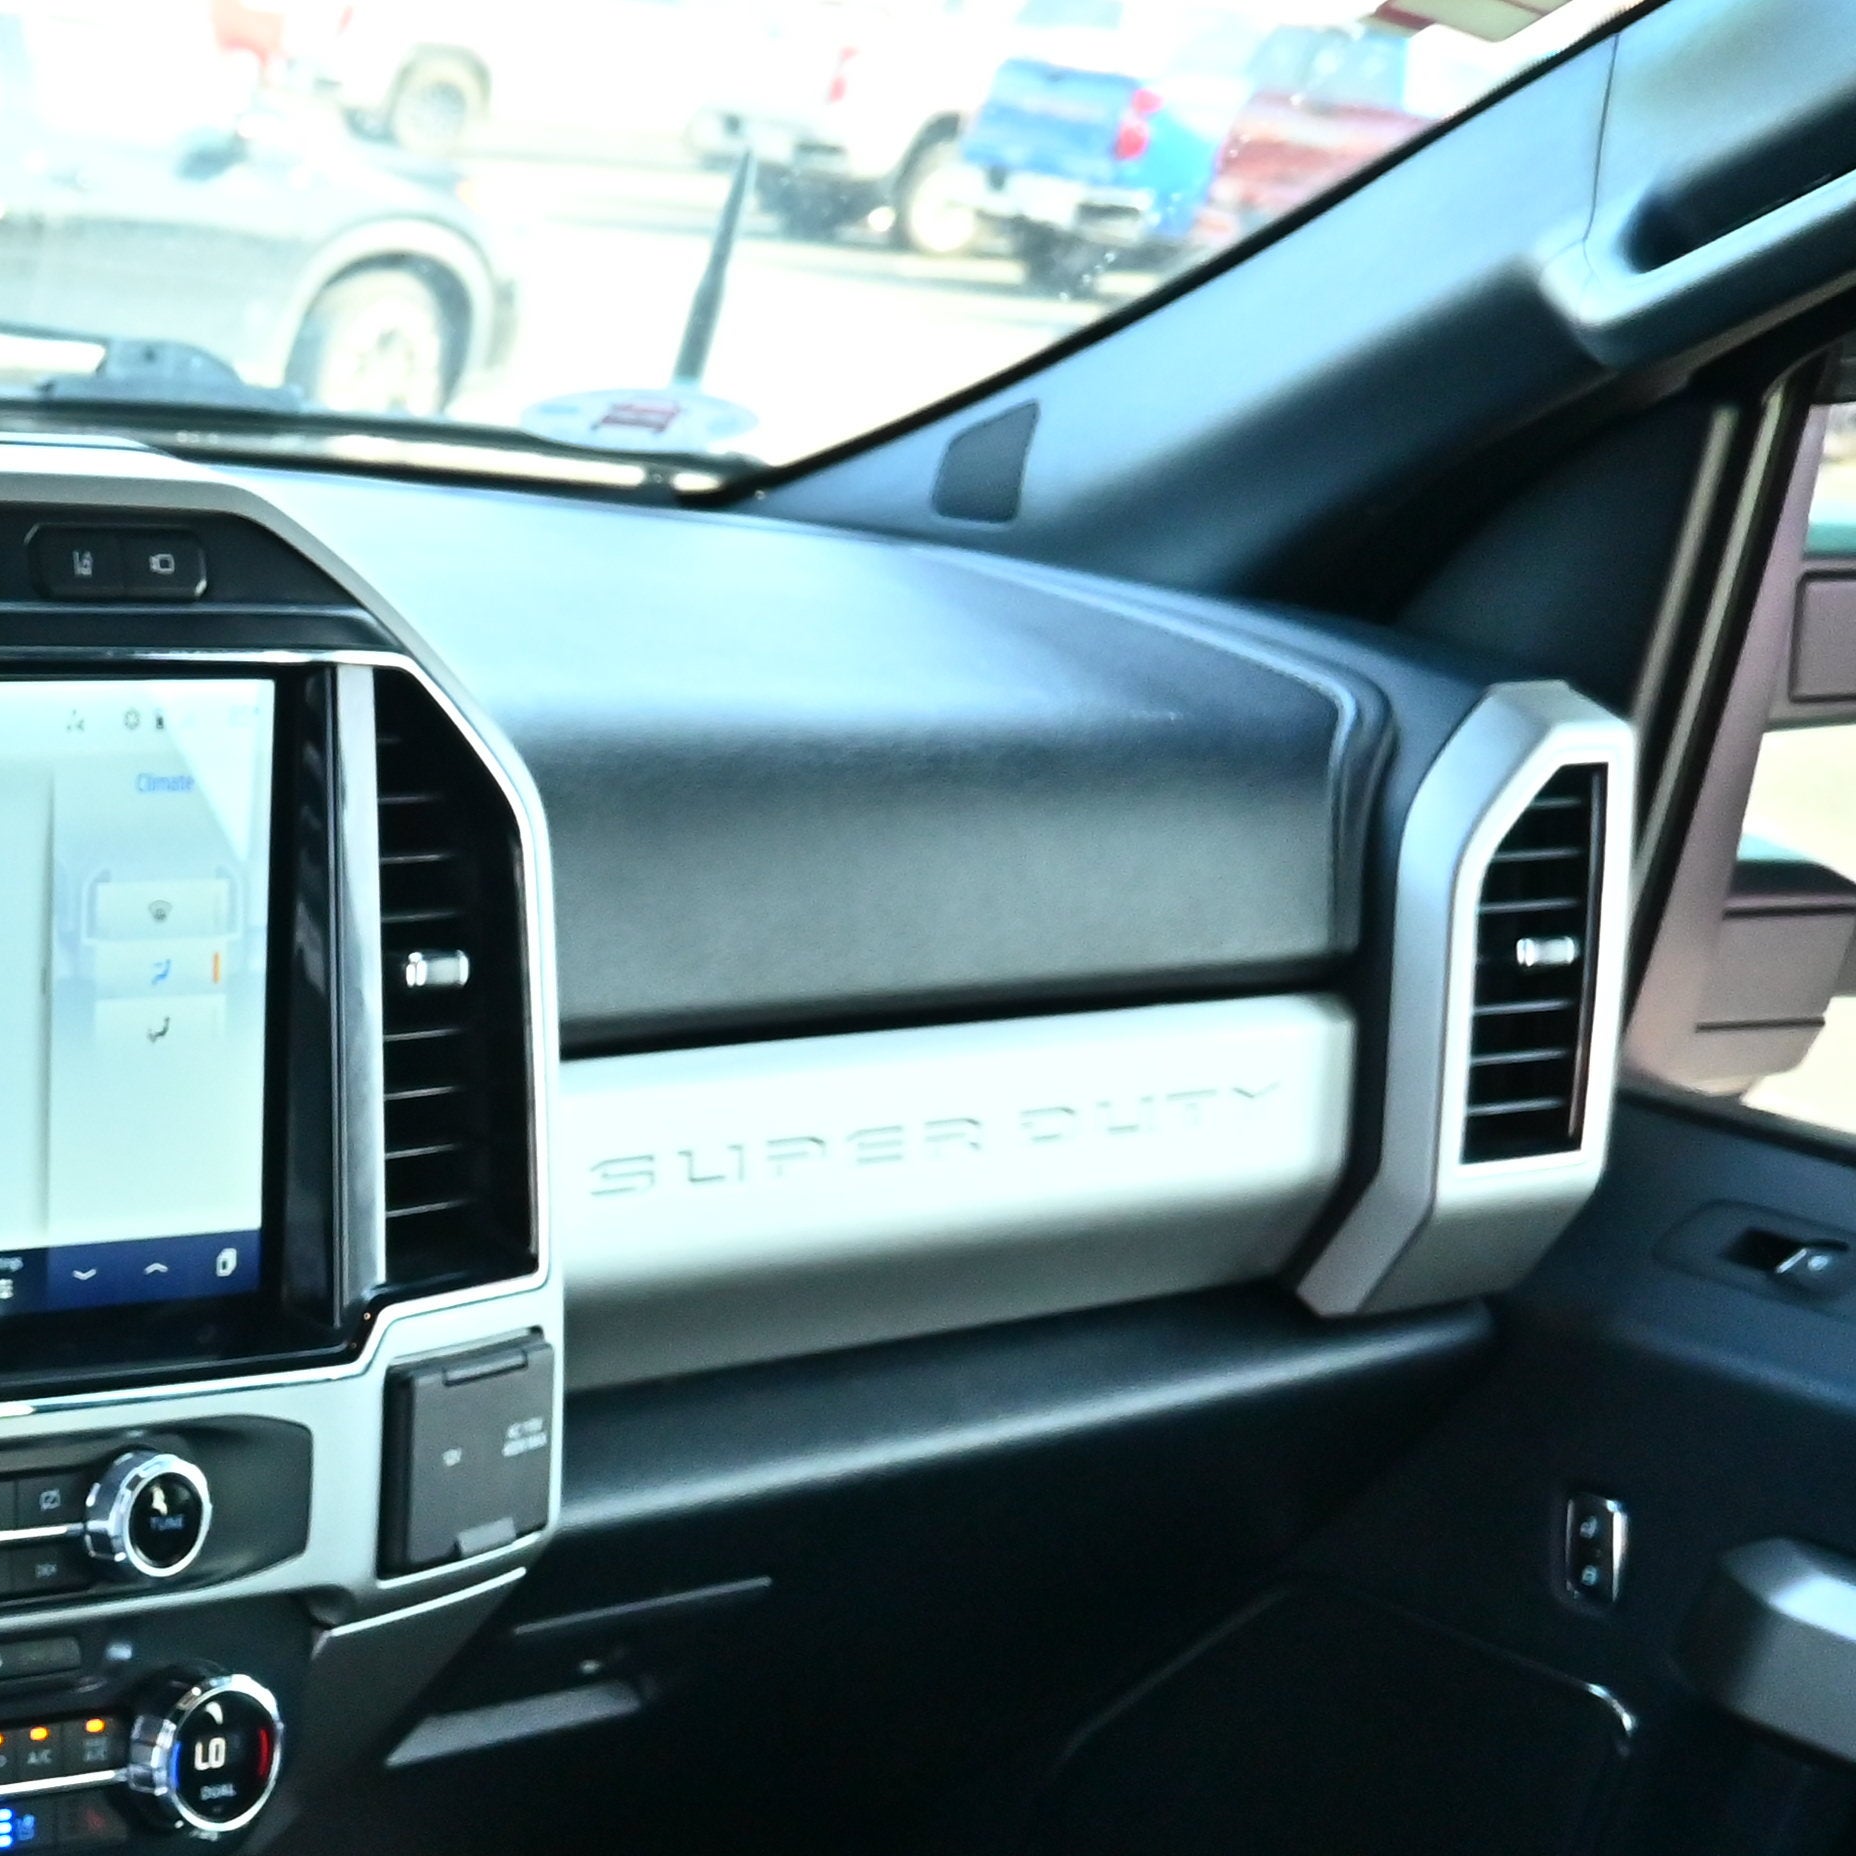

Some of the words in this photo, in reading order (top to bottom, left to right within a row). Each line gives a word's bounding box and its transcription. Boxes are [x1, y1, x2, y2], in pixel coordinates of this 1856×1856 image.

[136, 772, 195, 793] Climate
[590, 1115, 983, 1198] SUPER
[1019, 1080, 1282, 1144] DUTY
